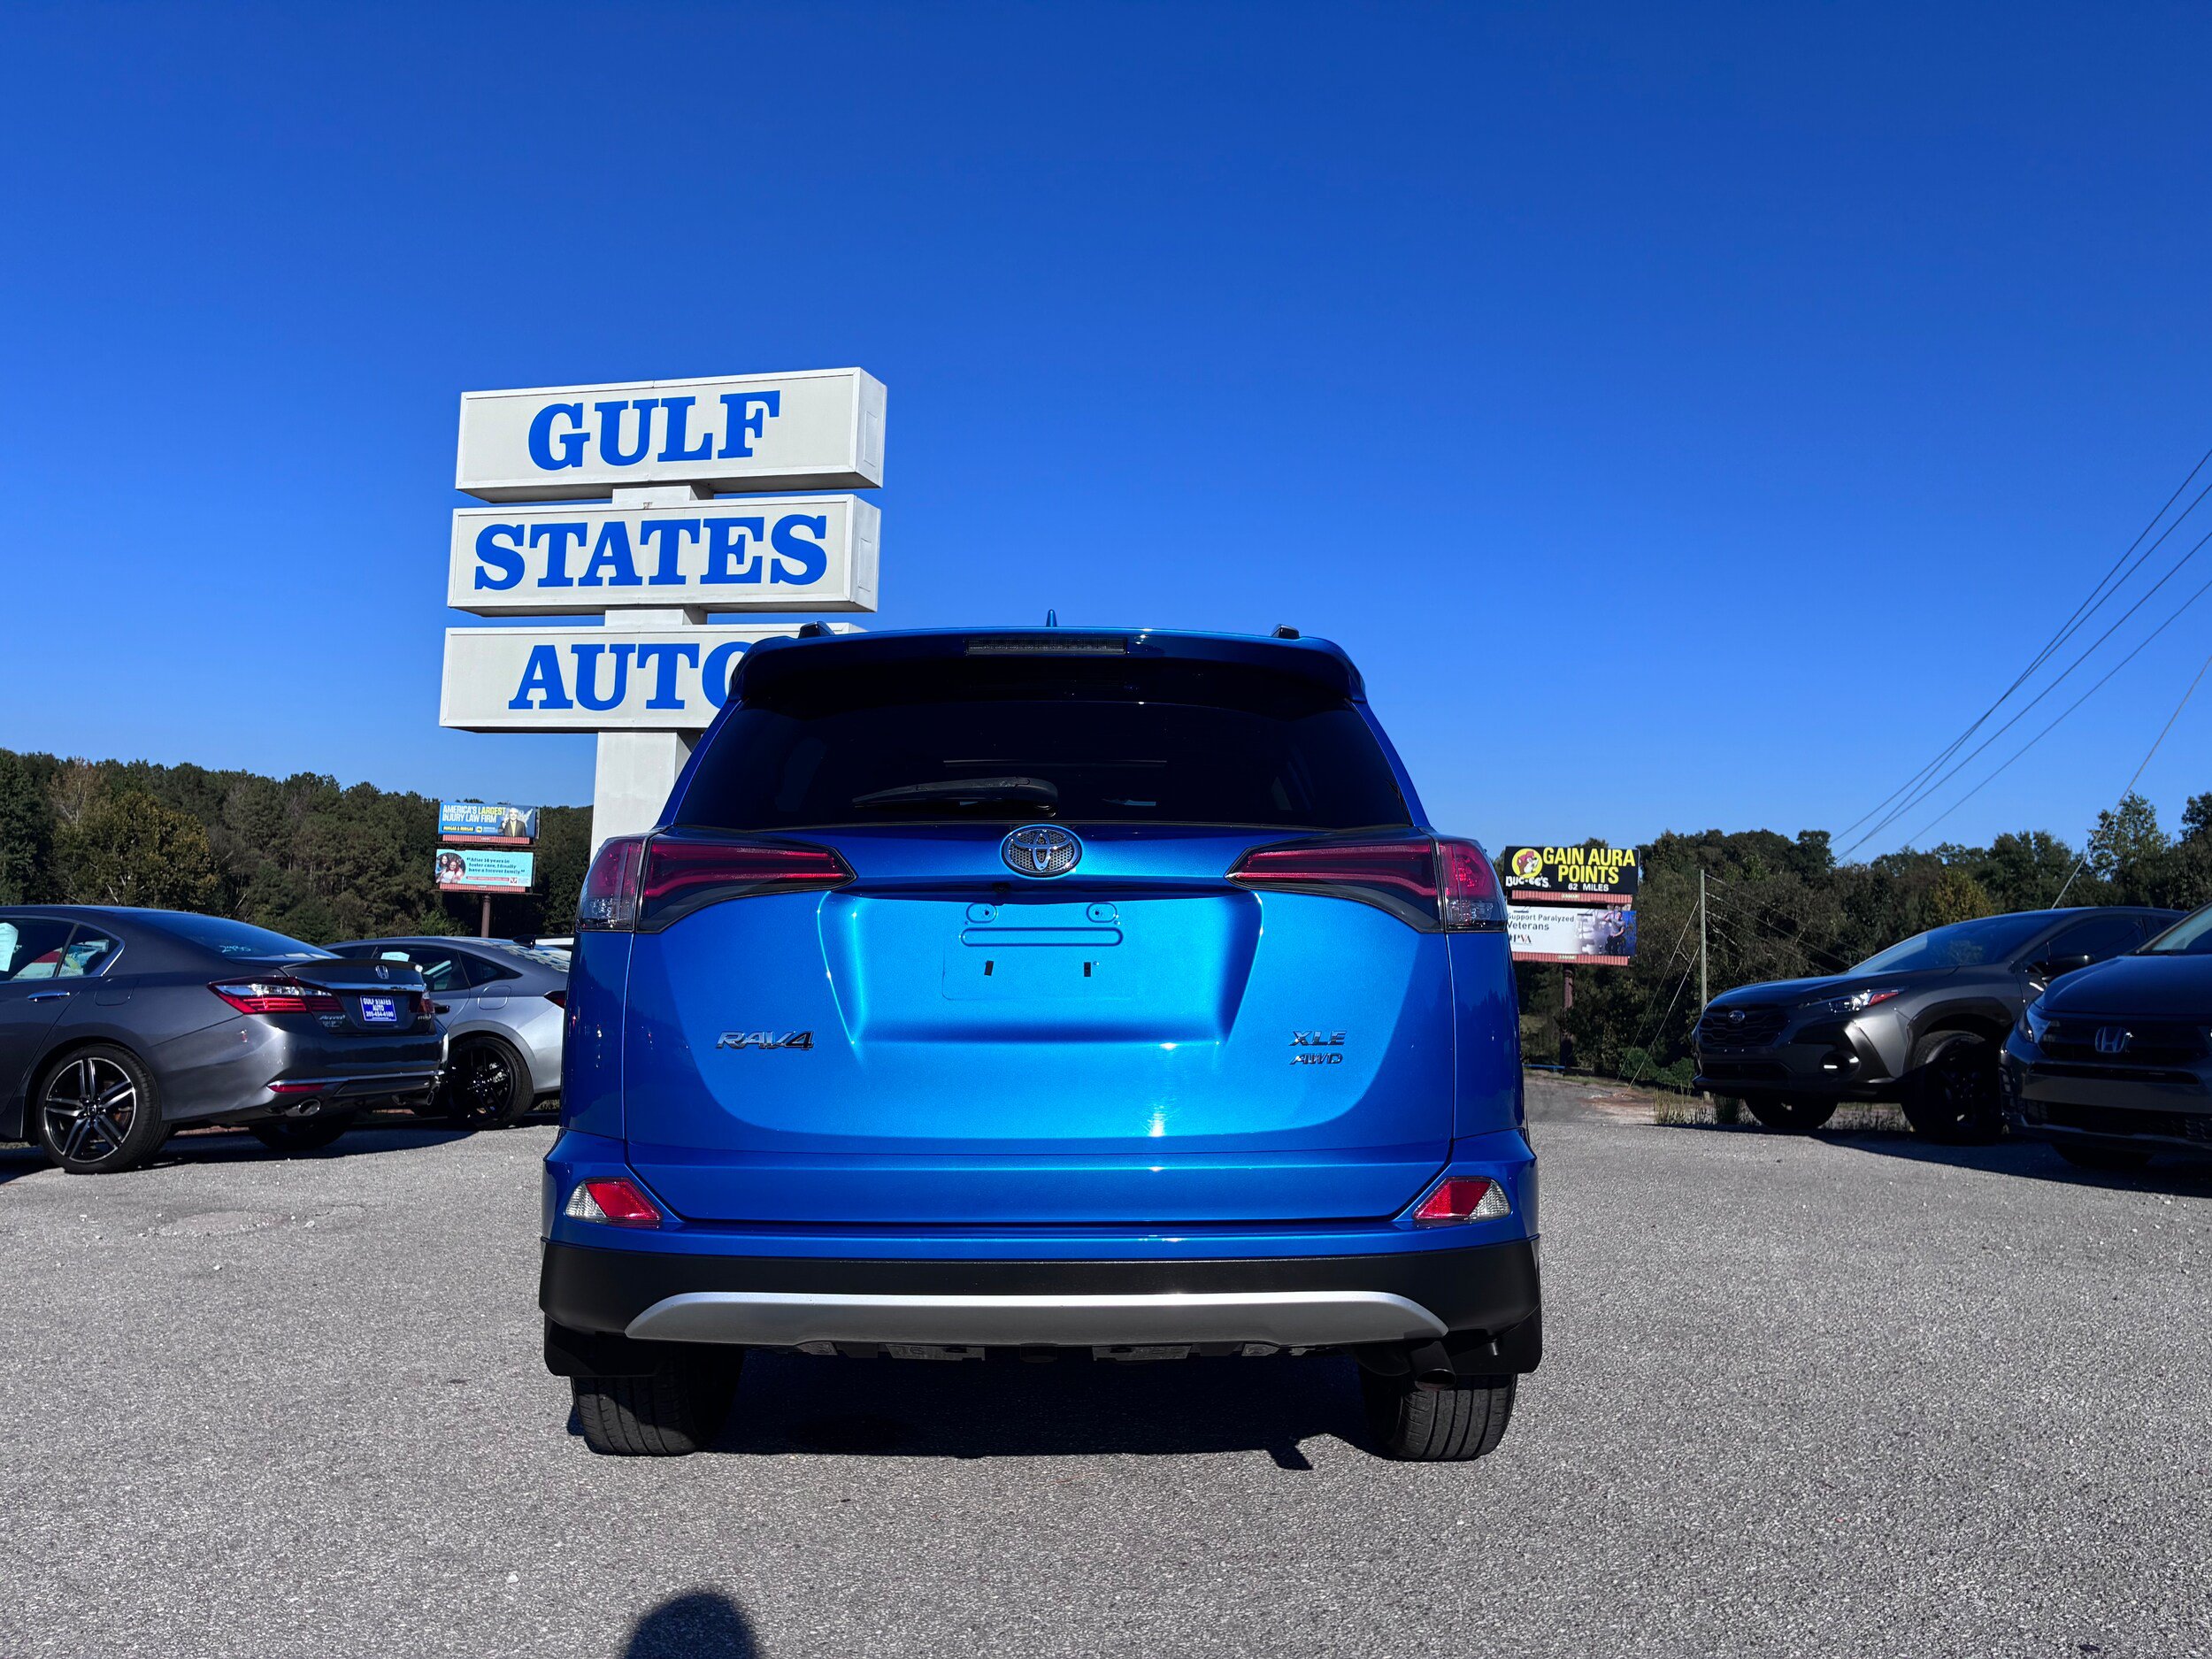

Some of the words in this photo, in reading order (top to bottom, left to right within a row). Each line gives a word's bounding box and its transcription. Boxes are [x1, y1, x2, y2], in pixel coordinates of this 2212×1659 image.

[528, 390, 780, 471] GULF
[474, 514, 827, 591] STATES
[443, 804, 477, 814] AMERICA'S
[478, 806, 506, 816] LARGEST
[442, 812, 465, 822] INJURY
[465, 813, 480, 823] LAW
[480, 814, 497, 824] FIRM
[1542, 847, 1584, 864] GAIN
[1587, 848, 1636, 867] AURA
[1558, 864, 1619, 884] POINTS
[1582, 883, 1609, 892] MILES
[1538, 913, 1574, 923] Paralyzed
[1507, 920, 1549, 931] Veterans
[716, 1031, 815, 1050] RAV4
[1288, 1030, 1348, 1047] XLE
[1289, 1053, 1344, 1065] AWD
